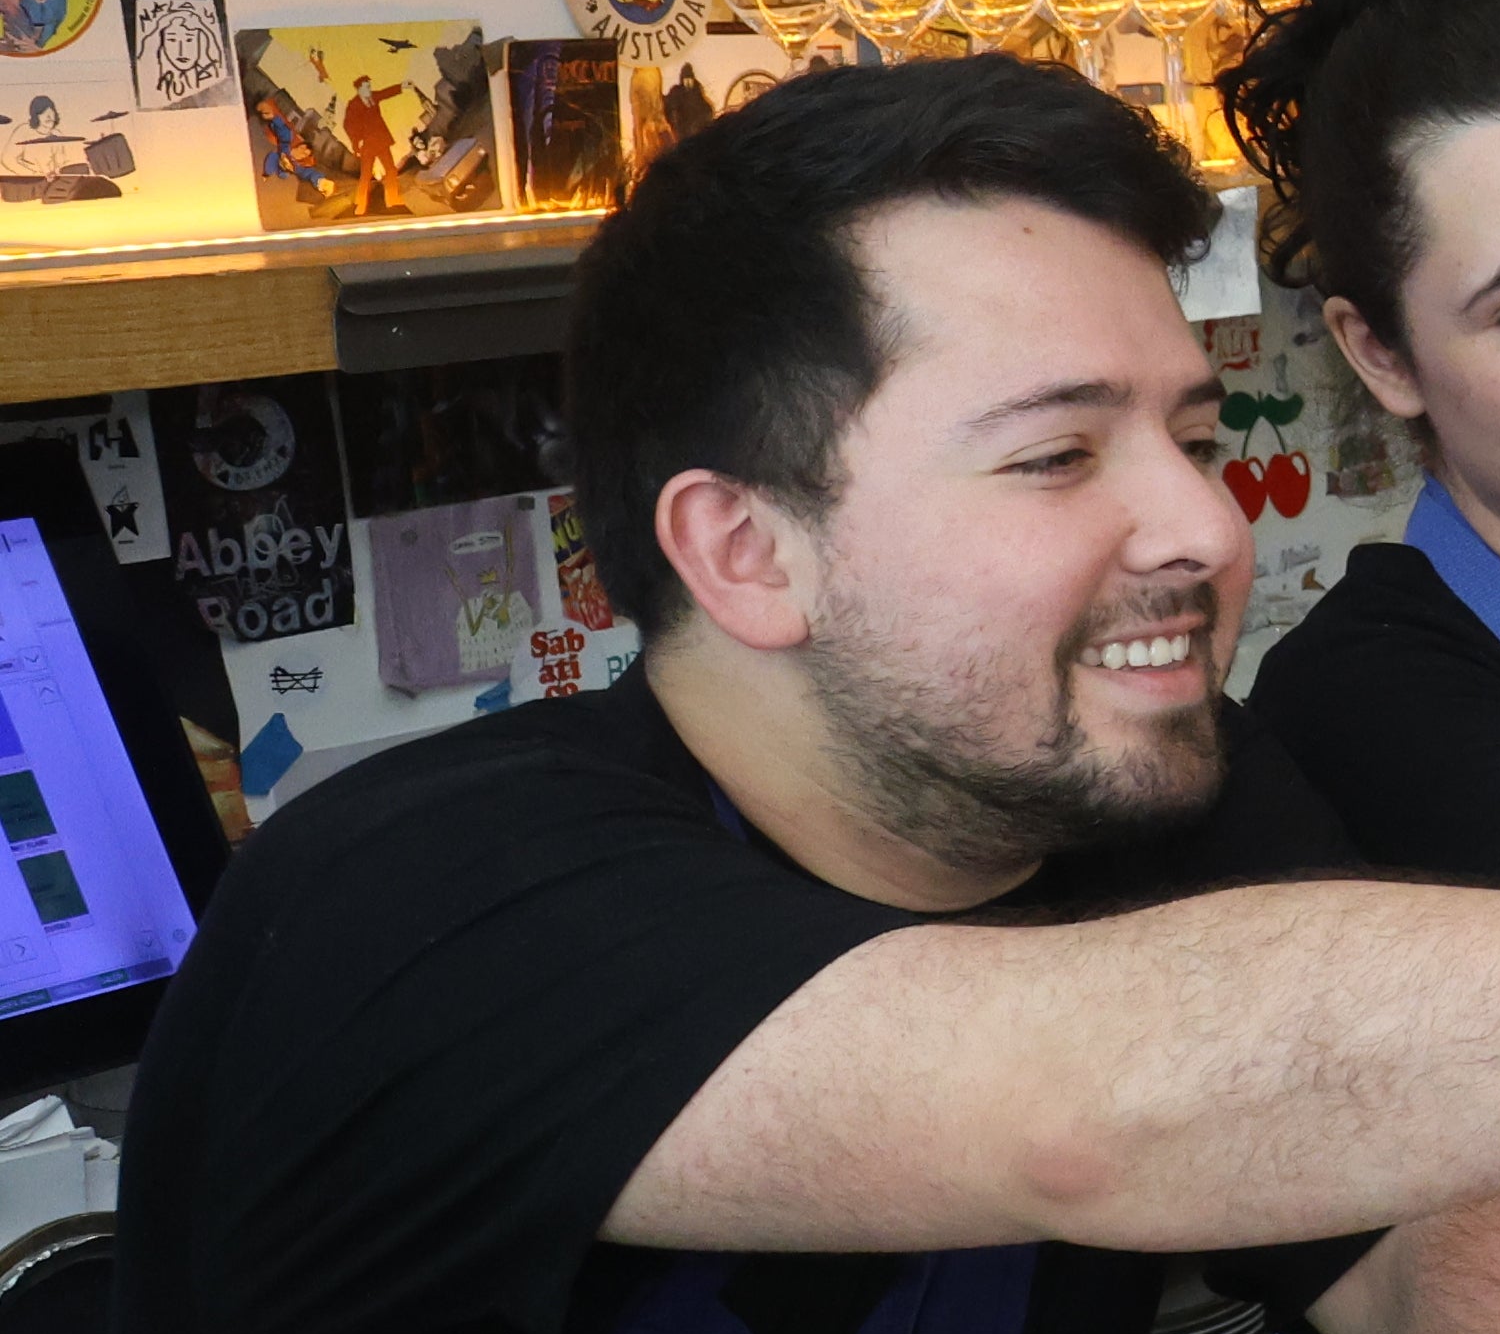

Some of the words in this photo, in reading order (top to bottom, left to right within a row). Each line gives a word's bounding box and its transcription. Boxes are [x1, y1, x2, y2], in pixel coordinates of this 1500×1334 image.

[174, 522, 344, 582] Abbey
[196, 577, 334, 640] Road
[530, 627, 585, 658] Sab
[538, 654, 582, 685] ati
